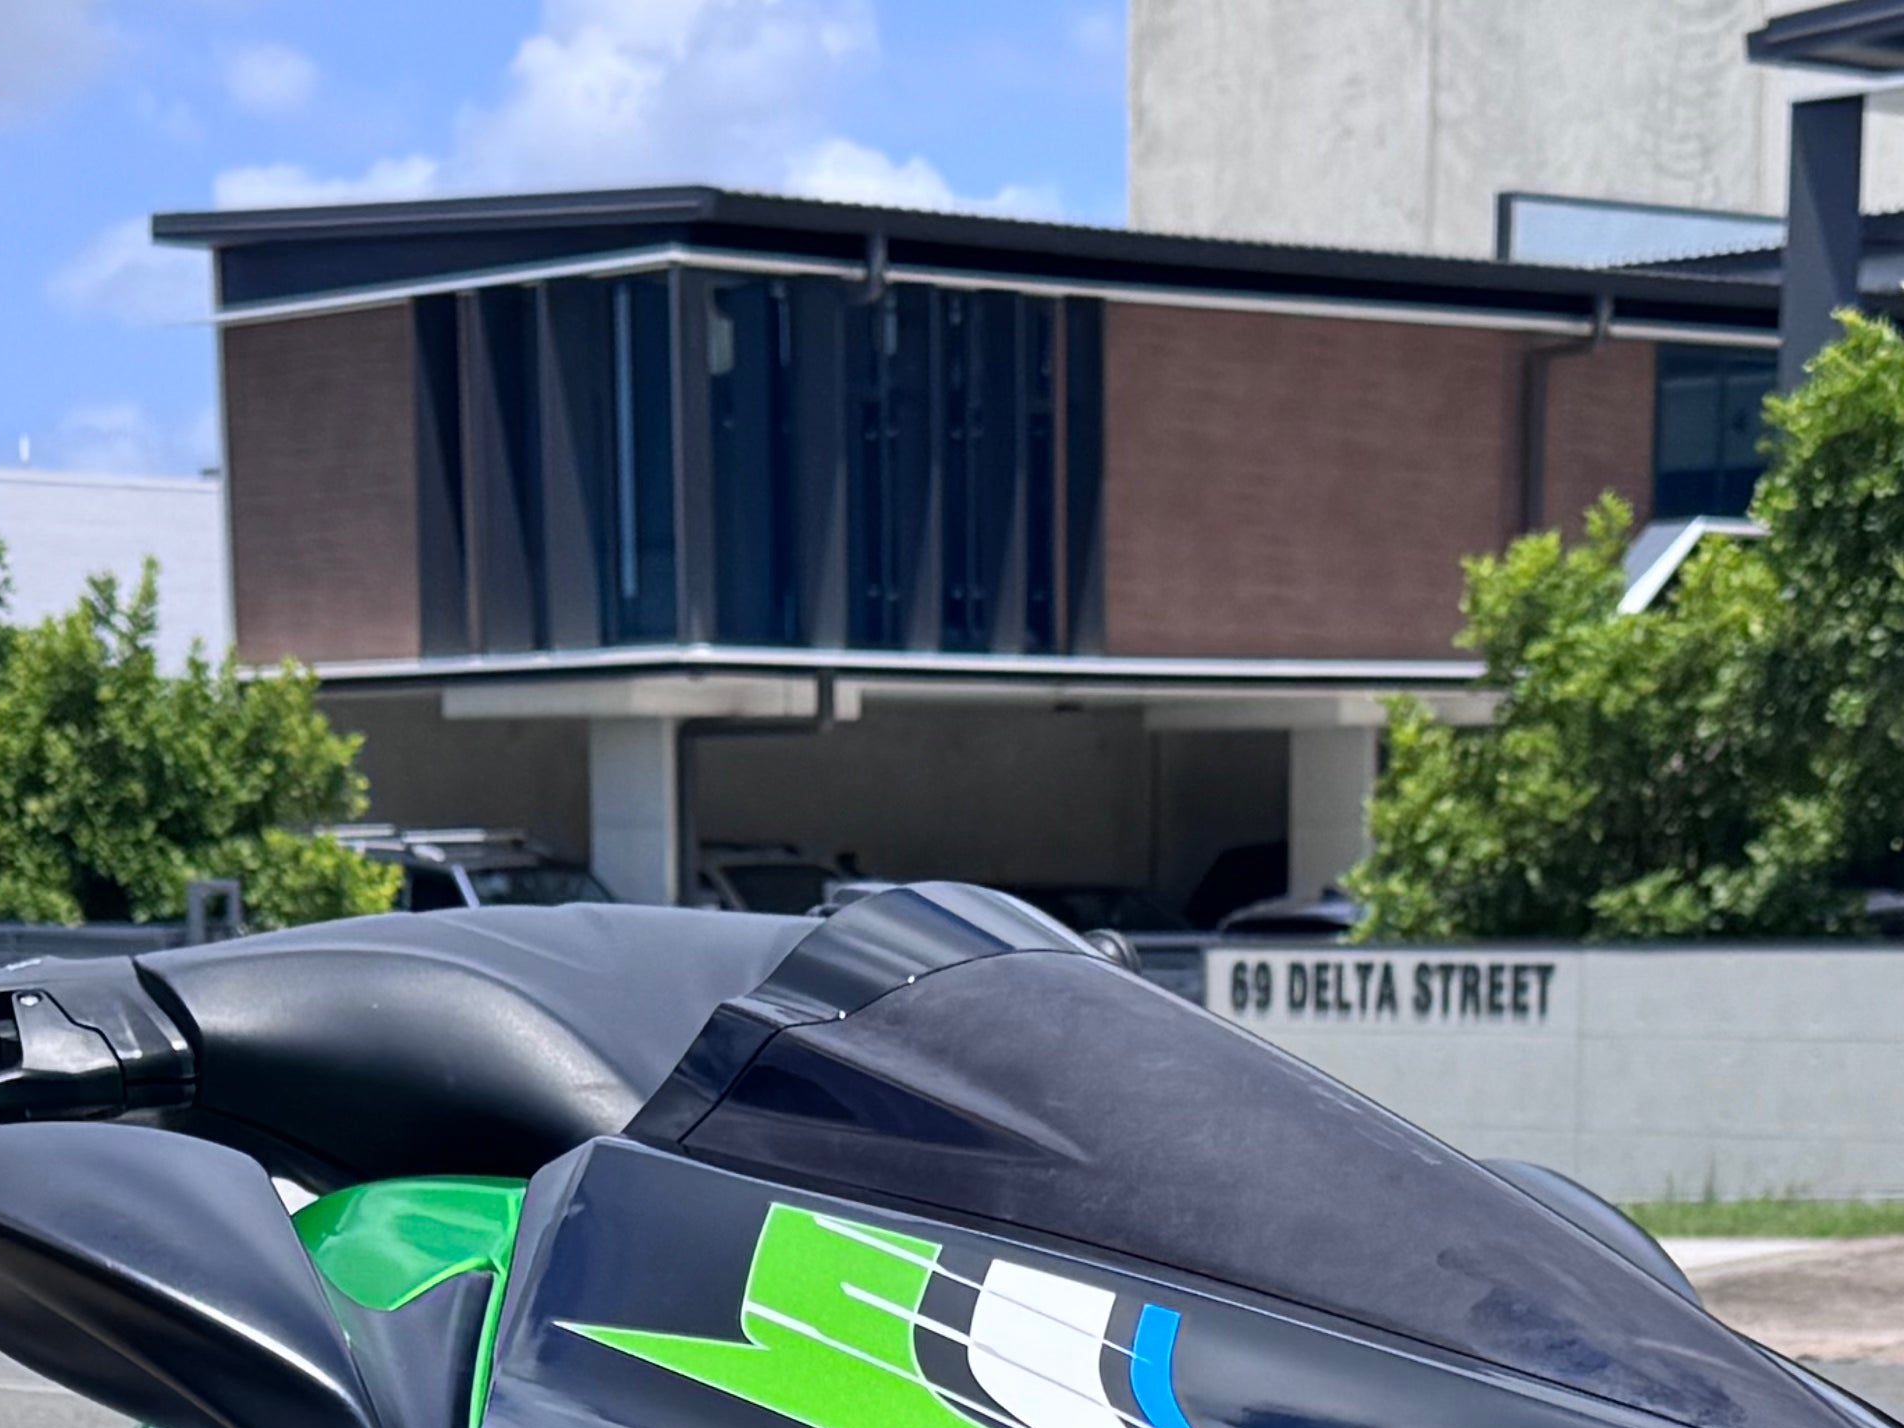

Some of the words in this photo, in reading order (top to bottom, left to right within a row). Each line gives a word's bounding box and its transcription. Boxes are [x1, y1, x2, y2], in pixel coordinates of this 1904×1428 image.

[1231, 961, 1273, 1011] 69
[1288, 962, 1395, 1014] DELTA
[1412, 963, 1555, 1016] STREET
